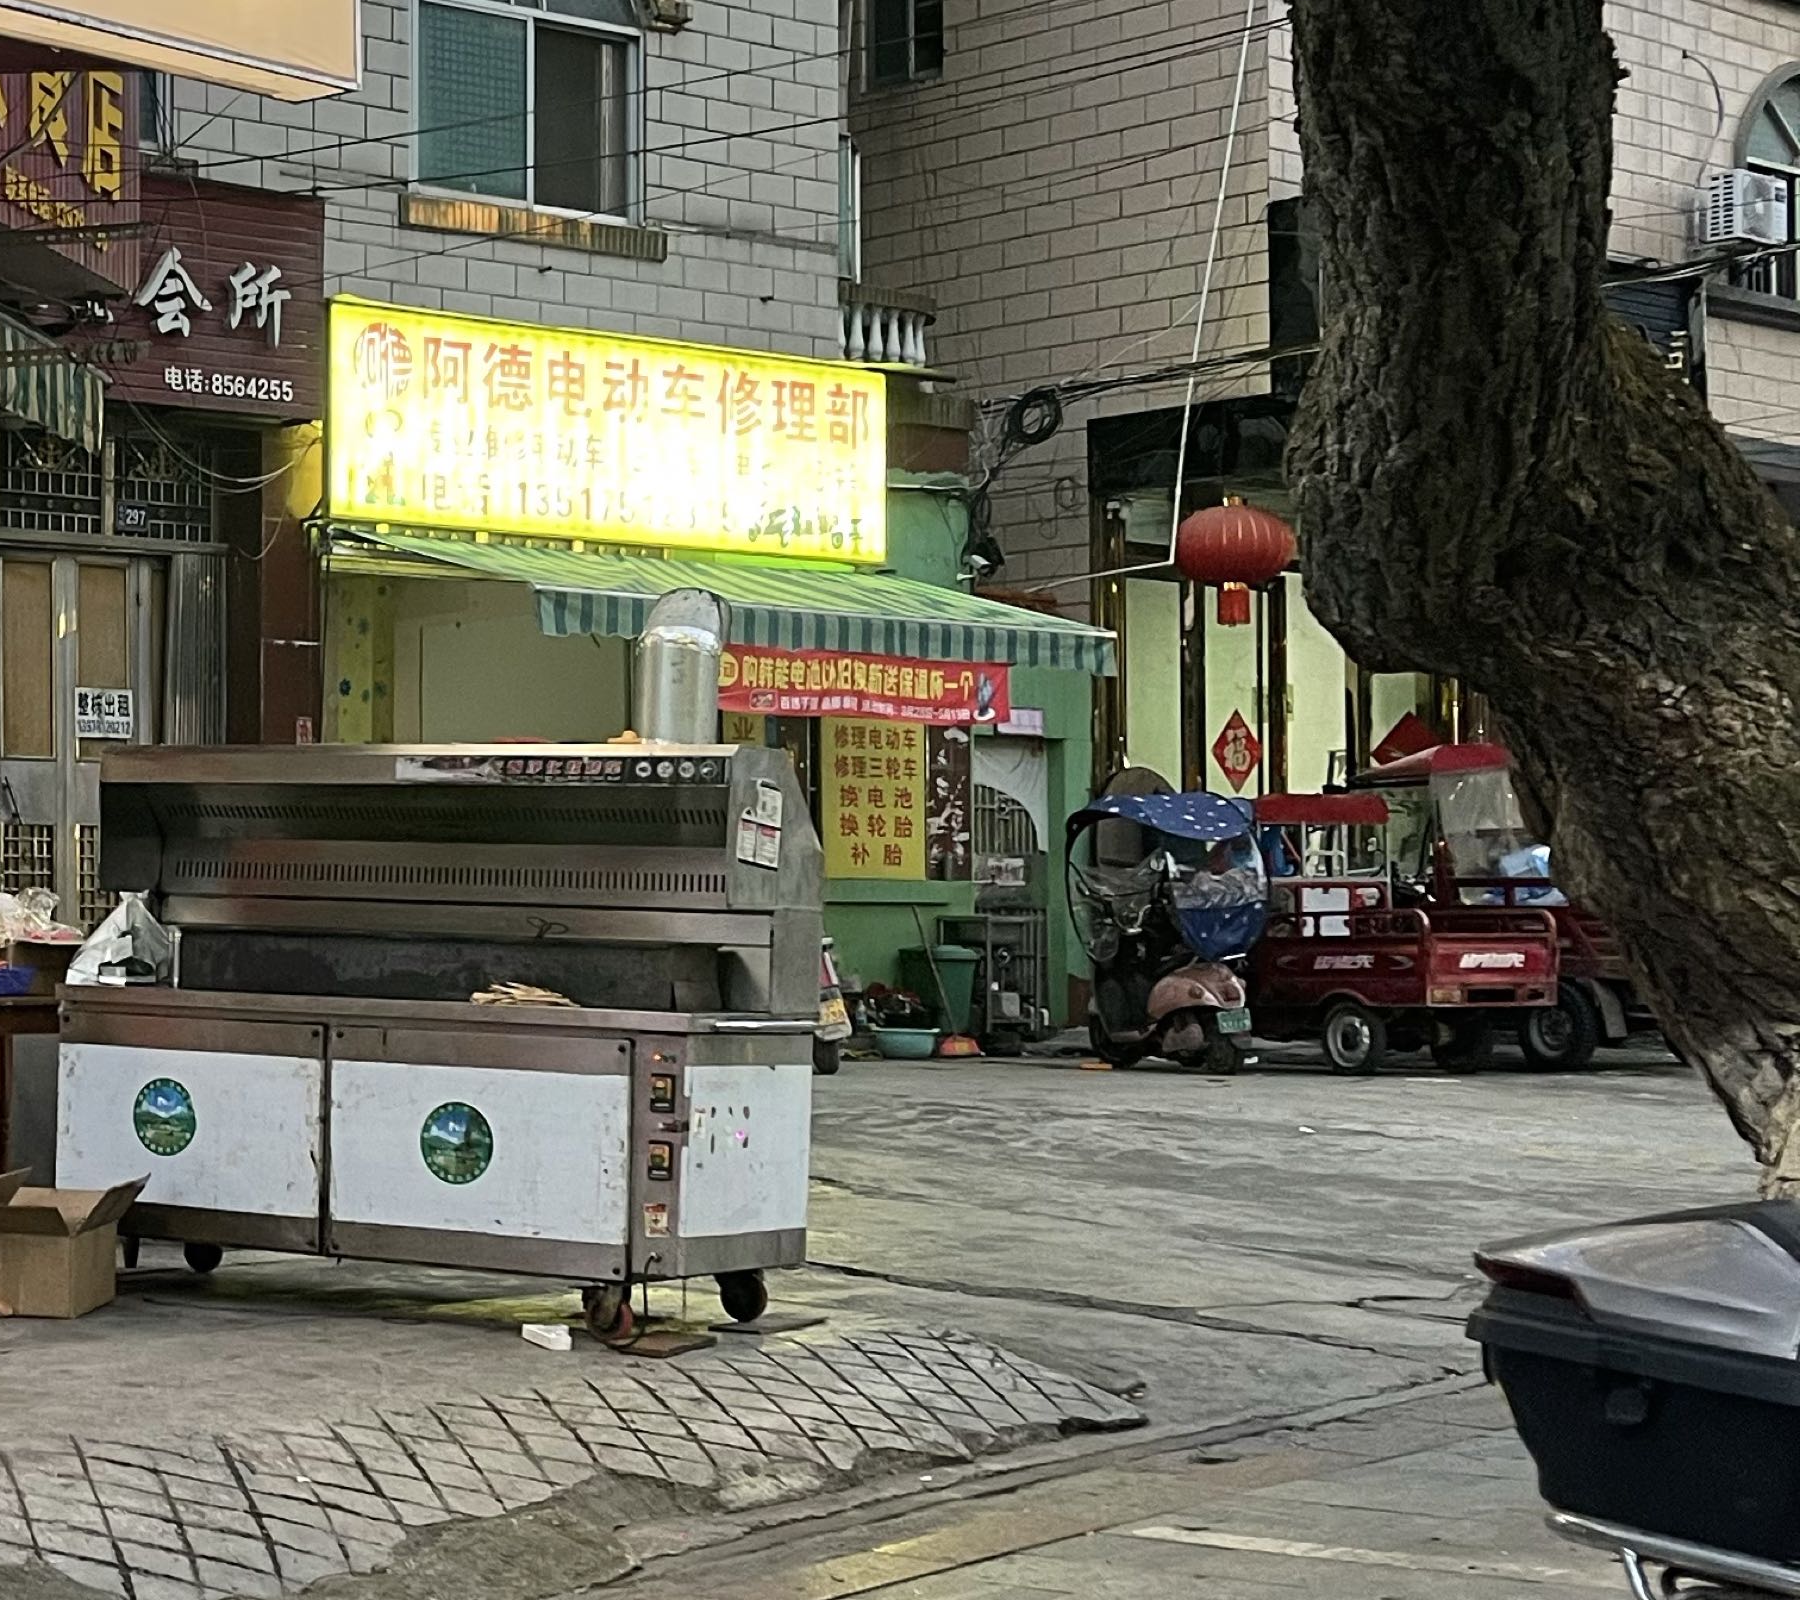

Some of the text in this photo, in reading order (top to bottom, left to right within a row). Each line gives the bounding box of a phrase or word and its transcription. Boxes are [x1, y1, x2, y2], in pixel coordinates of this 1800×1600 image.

[423, 335, 870, 450] 阿德电动车修理部
[834, 723, 917, 751] 修理电动车
[834, 754, 918, 781] 修理三轮车
[839, 784, 913, 809] 换电池
[839, 813, 914, 839] 换轮胎
[851, 843, 903, 867] 补胎
